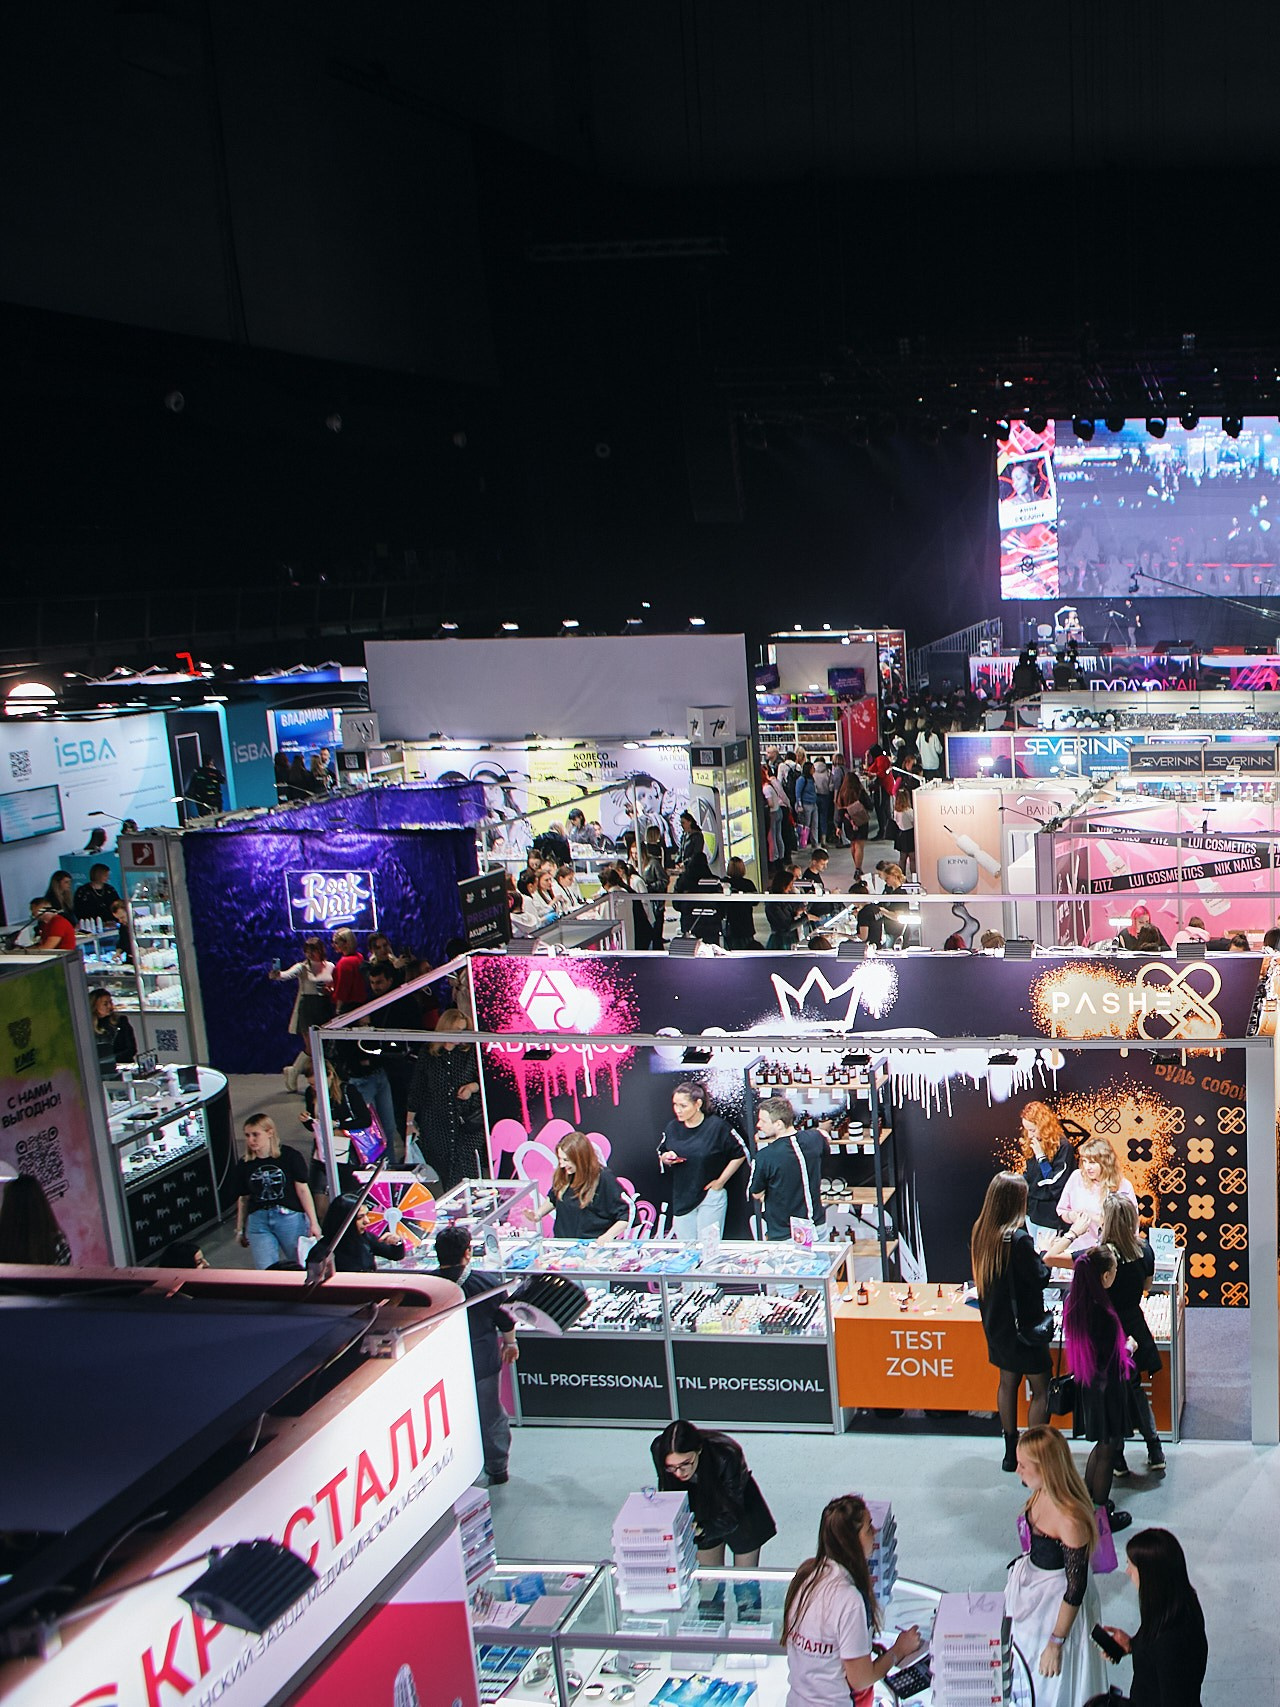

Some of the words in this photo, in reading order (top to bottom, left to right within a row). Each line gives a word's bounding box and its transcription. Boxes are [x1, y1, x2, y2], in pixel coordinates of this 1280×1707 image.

[573, 752, 609, 760] КОЛЕСО
[1015, 738, 1129, 756] SEVERINA
[573, 760, 619, 769] ФОРТУНЫ
[1139, 757, 1200, 766] SEVERINA
[1207, 757, 1273, 766] SEVERINA
[940, 805, 975, 815] BANDI
[1188, 837, 1203, 849] LUI
[1205, 838, 1257, 855] COSMETICS
[1093, 879, 1114, 893] ZITZ
[1129, 873, 1145, 888] LUI
[1146, 865, 1205, 884] COSMETICS
[1214, 860, 1232, 875] NIK
[1233, 856, 1262, 872] NAILS
[1051, 991, 1172, 1015] PASHE
[18, 1081, 53, 1105] НАМИ
[2, 1093, 62, 1129] ВЫГОДНО!
[890, 1330, 947, 1351] TEST
[886, 1357, 955, 1378] ZONE
[518, 1372, 549, 1386] TNL
[550, 1373, 663, 1389] PROFESSIONAL
[676, 1376, 707, 1390] TNL
[709, 1377, 825, 1393] PROFESSIONAL
[141, 1378, 451, 1707] КРСТАЛЛ
[254, 1598, 306, 1661] ЗАВОД
